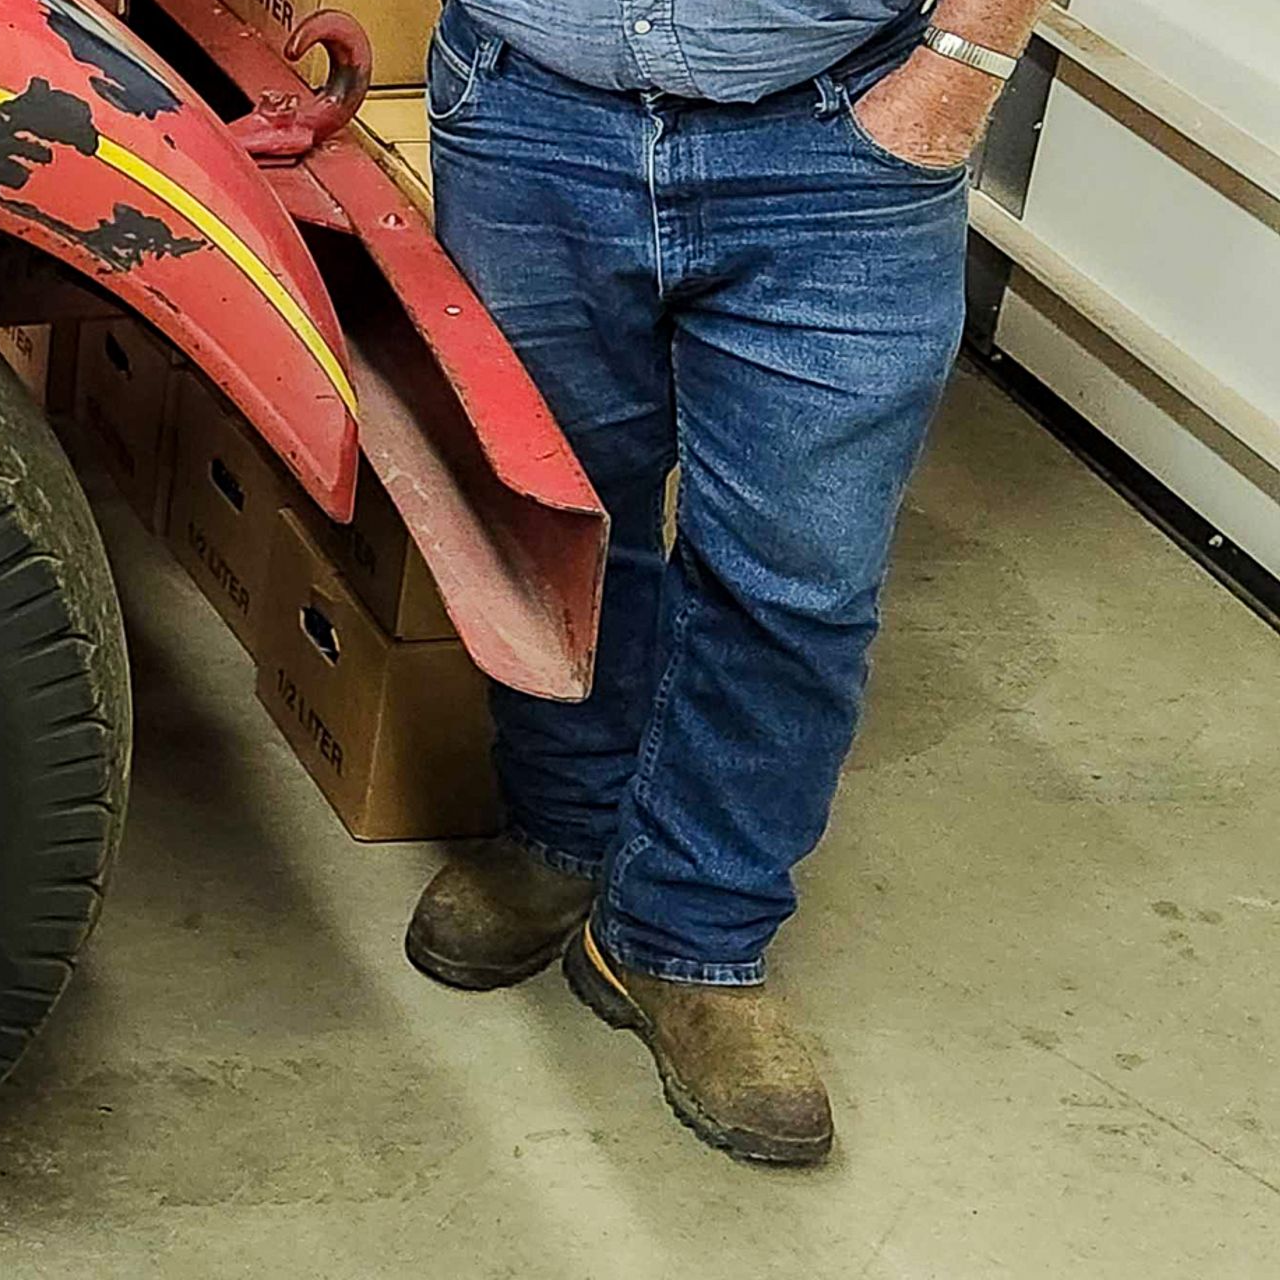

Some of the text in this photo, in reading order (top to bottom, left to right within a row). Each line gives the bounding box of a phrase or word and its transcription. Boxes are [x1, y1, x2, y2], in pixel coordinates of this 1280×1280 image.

[208, 557, 251, 616] LITER
[277, 668, 343, 775] 1/2 LITER
